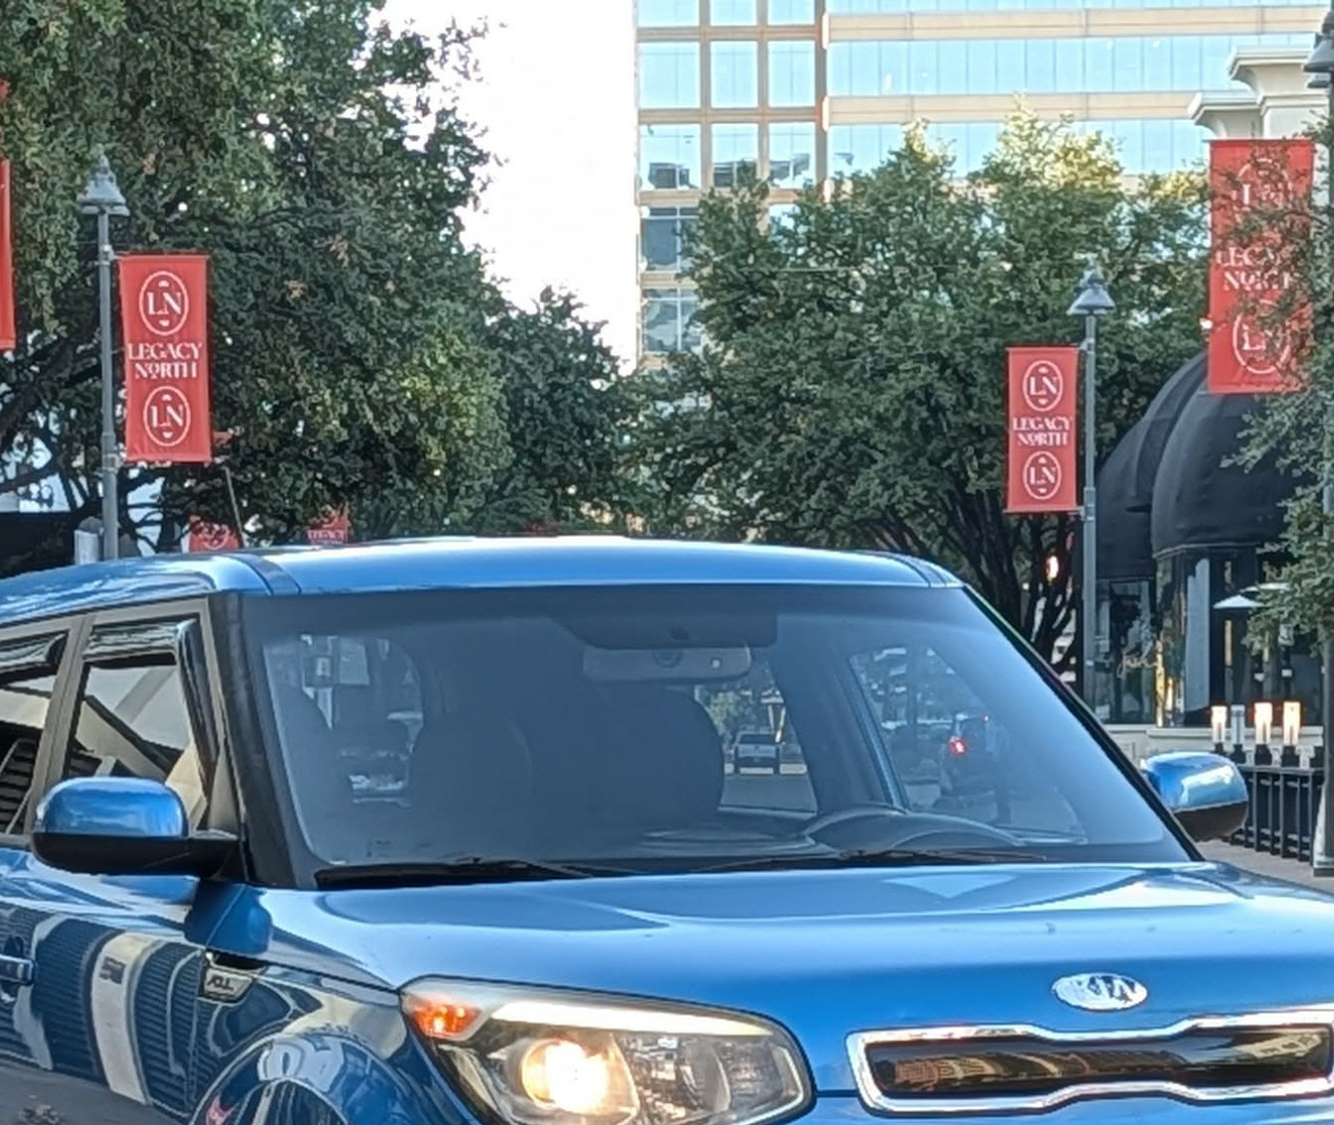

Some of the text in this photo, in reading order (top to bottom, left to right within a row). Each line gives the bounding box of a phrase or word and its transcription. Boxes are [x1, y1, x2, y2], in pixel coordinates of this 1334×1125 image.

[147, 291, 182, 316] LN
[128, 342, 203, 360] LEGACY
[135, 361, 198, 379] NORTH
[1030, 376, 1058, 395] LN
[151, 405, 184, 428] LN
[1013, 416, 1072, 431] LEGACY
[1017, 431, 1069, 446] NORTH
[1030, 466, 1056, 485] LN
